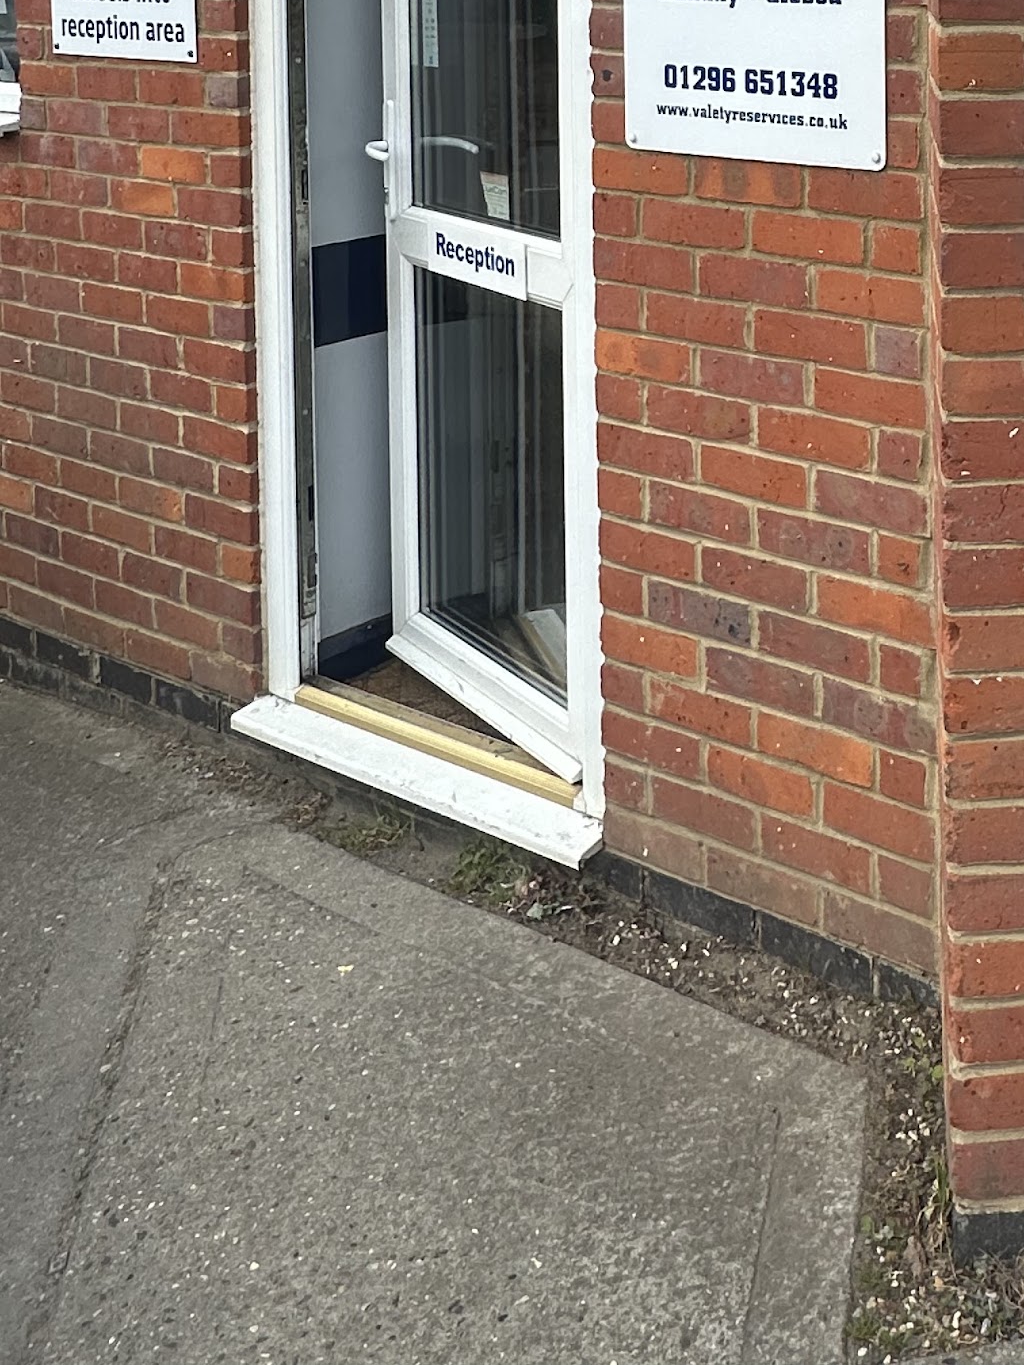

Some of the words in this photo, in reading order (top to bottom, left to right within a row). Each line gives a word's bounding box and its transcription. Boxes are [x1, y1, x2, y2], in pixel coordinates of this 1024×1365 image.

[61, 15, 140, 43] reception
[145, 22, 185, 43] area
[664, 64, 736, 92] 01296
[744, 69, 838, 99] 651348
[656, 103, 848, 130] www.valetyreservices.co.uk
[436, 232, 515, 277] Reception
